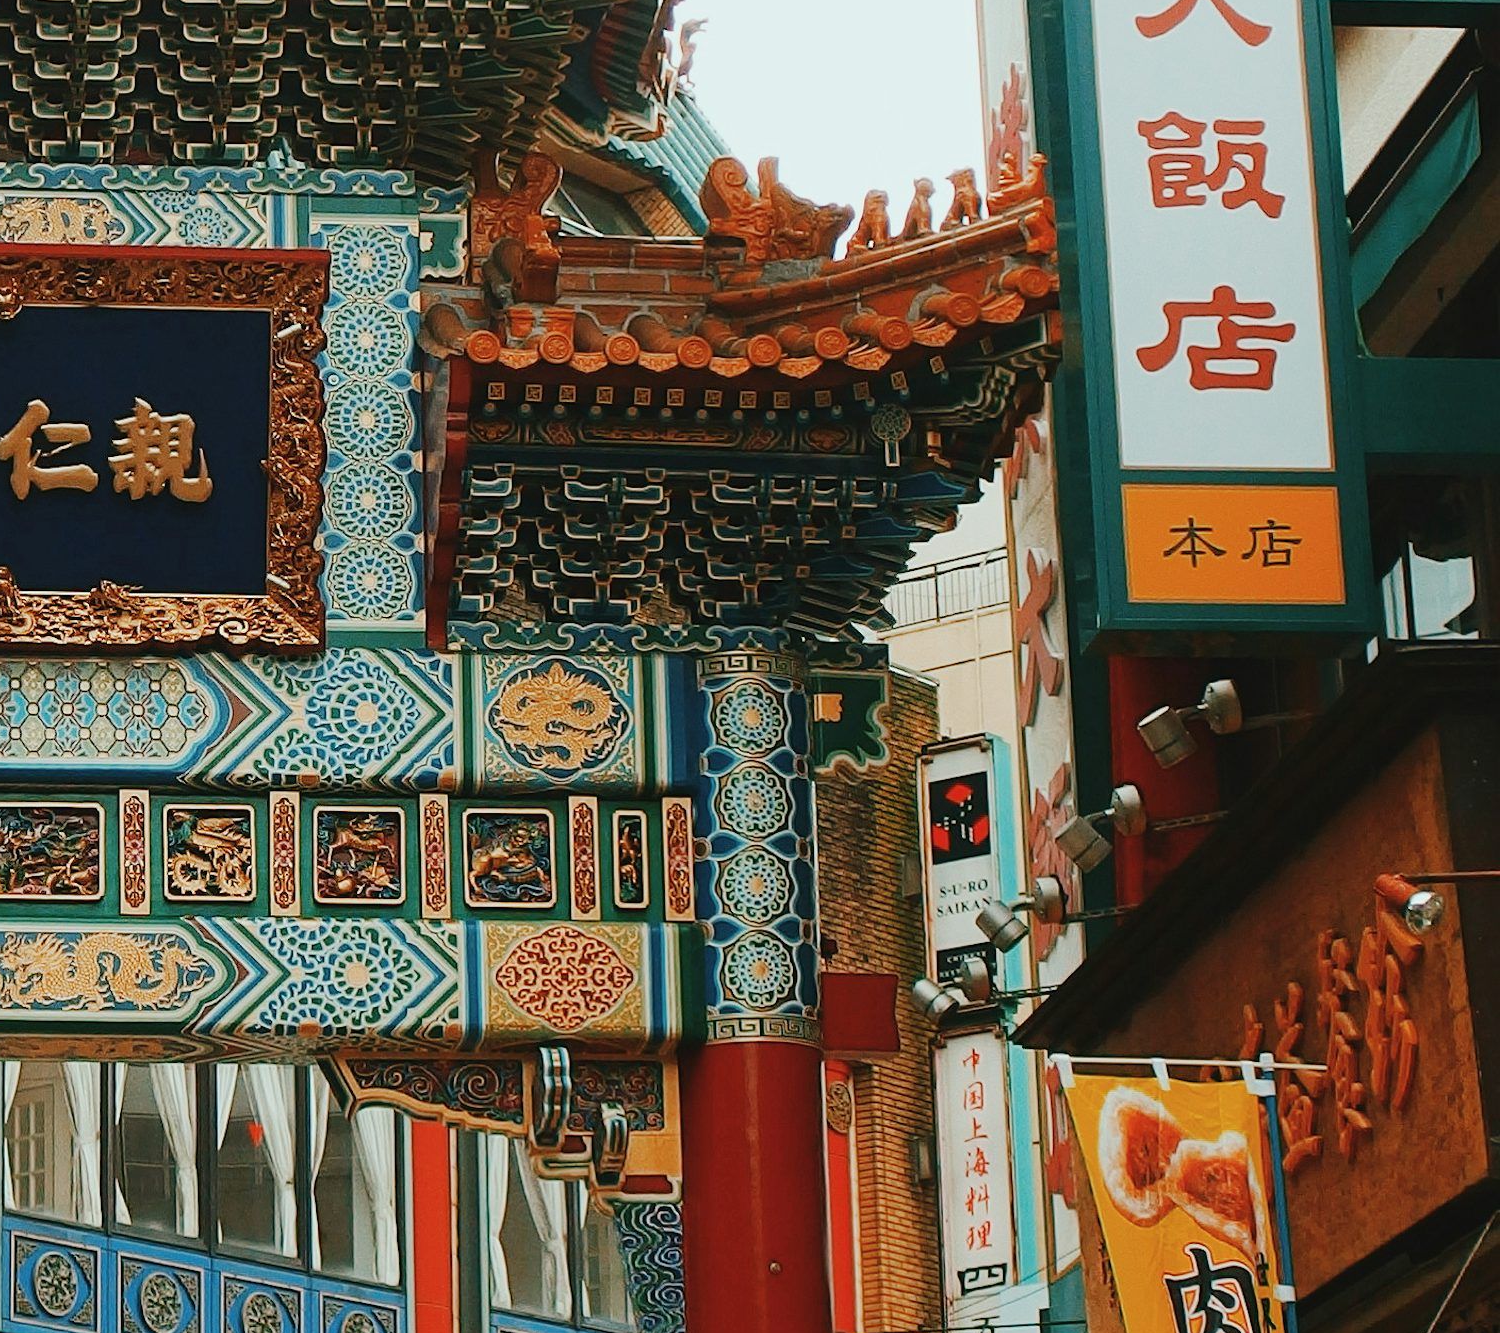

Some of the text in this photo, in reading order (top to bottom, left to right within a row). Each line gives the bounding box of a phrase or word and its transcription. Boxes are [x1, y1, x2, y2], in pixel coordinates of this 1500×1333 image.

[1163, 517, 1302, 568] 本店
[936, 895, 993, 918] SAIKAN
[939, 877, 989, 899] S-U-RO
[961, 1048, 994, 1250] 中国上海料理
